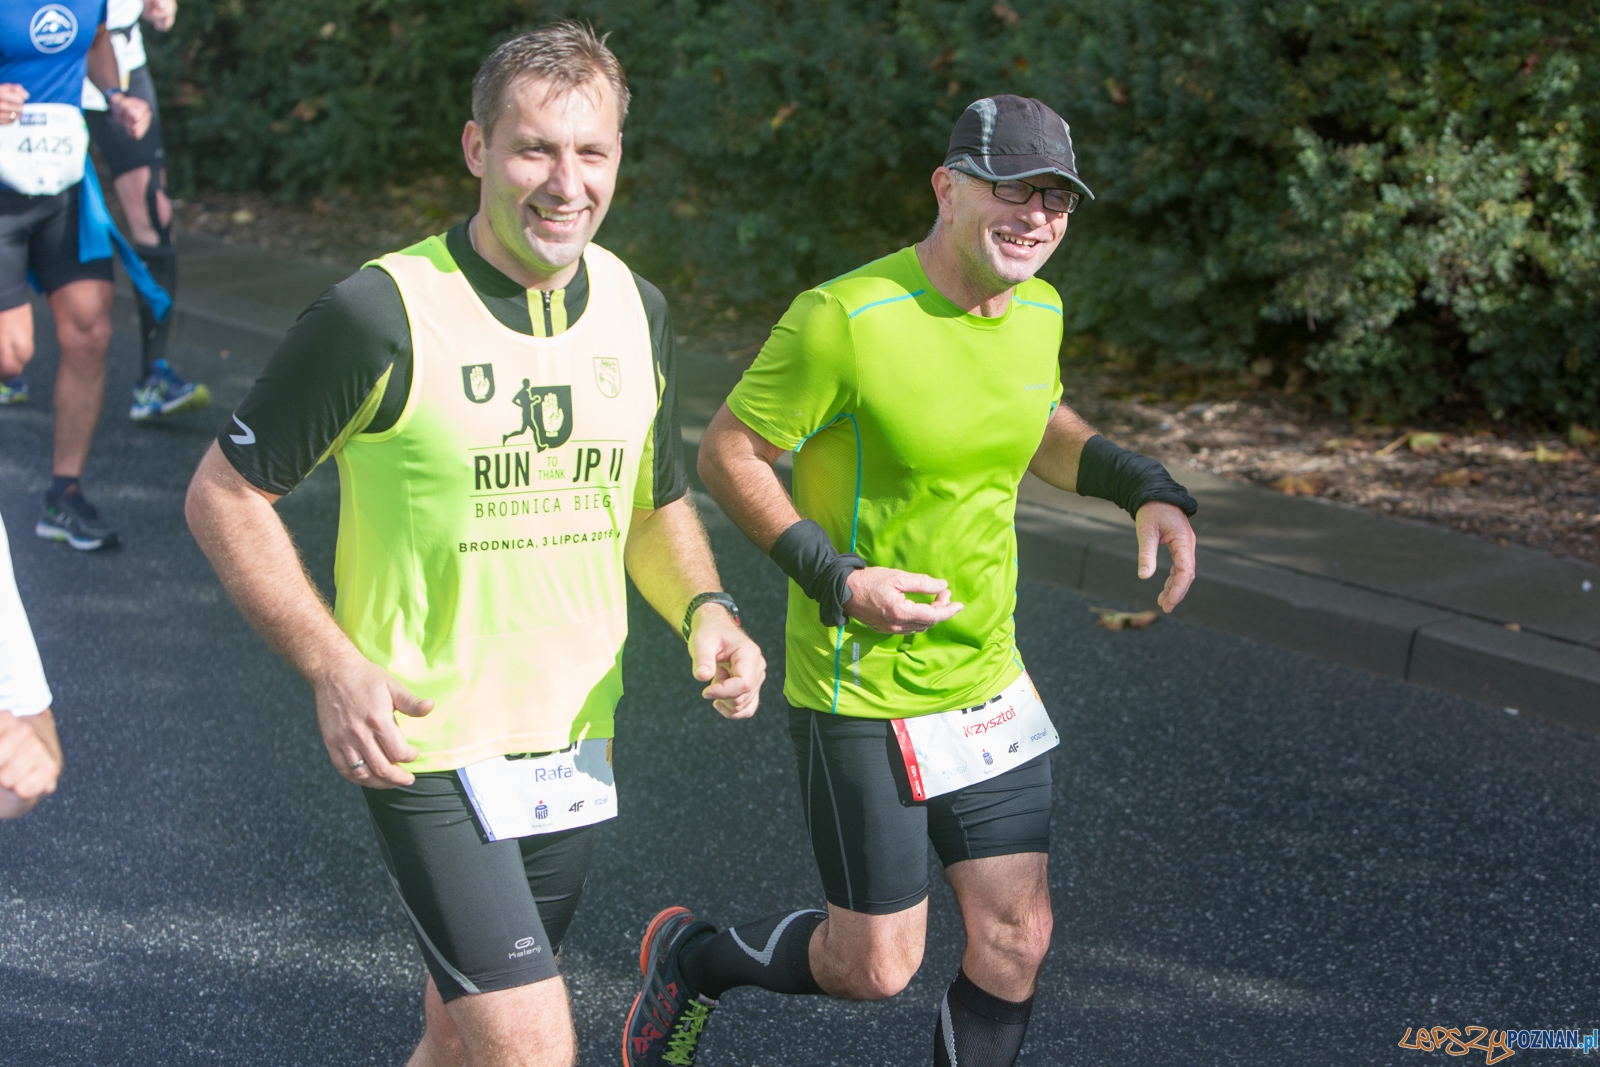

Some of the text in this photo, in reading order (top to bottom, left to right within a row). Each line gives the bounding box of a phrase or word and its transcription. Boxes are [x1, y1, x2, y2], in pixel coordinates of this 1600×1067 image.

[18, 136, 73, 154] 4425
[474, 451, 530, 490] RUN
[547, 456, 558, 467] TO
[572, 448, 601, 482] JP
[538, 469, 566, 481] THANK
[475, 498, 561, 518] BRODNICA
[459, 538, 538, 553] BRODNICA,
[542, 537, 548, 546] 3
[552, 533, 588, 545] LIPCA
[963, 705, 1016, 738] Krzysztof
[568, 800, 585, 812] 4F
